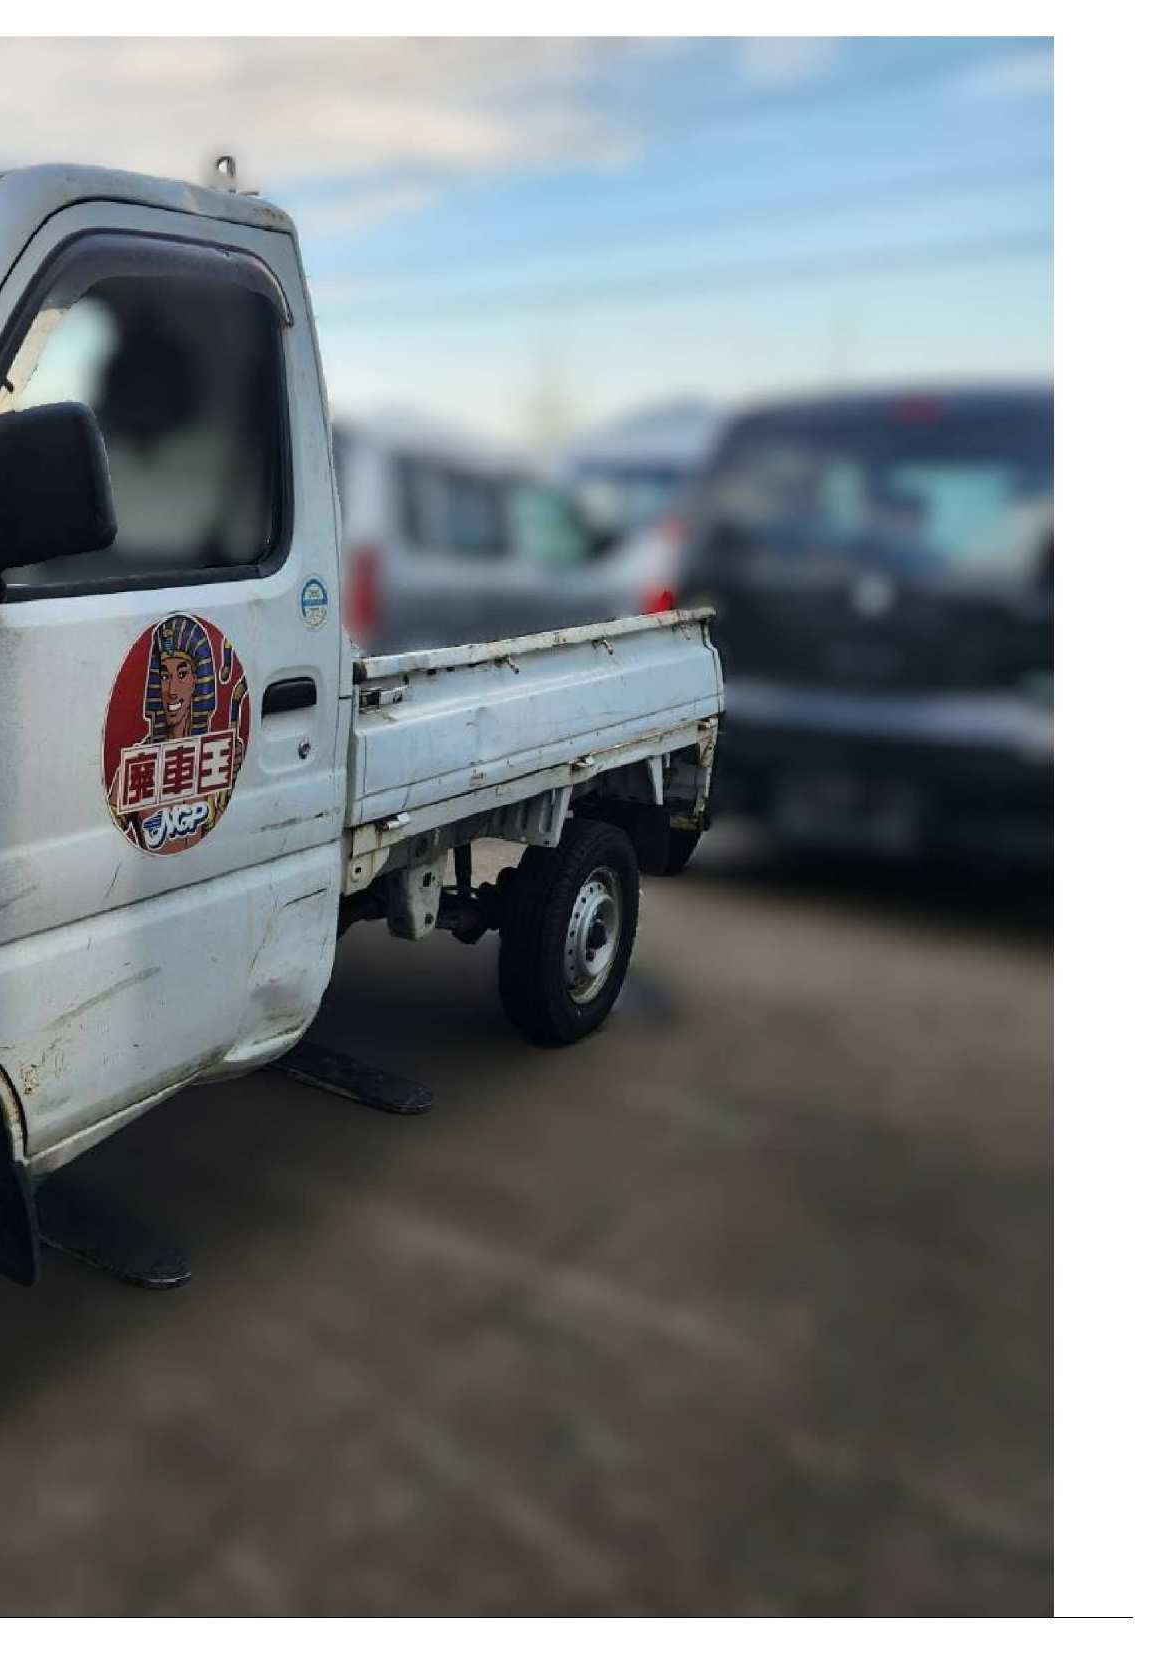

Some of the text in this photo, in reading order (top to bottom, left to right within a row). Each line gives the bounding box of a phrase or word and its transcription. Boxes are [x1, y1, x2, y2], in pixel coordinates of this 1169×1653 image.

[122, 735, 233, 807] 廃車王
[142, 801, 209, 850] NGP
